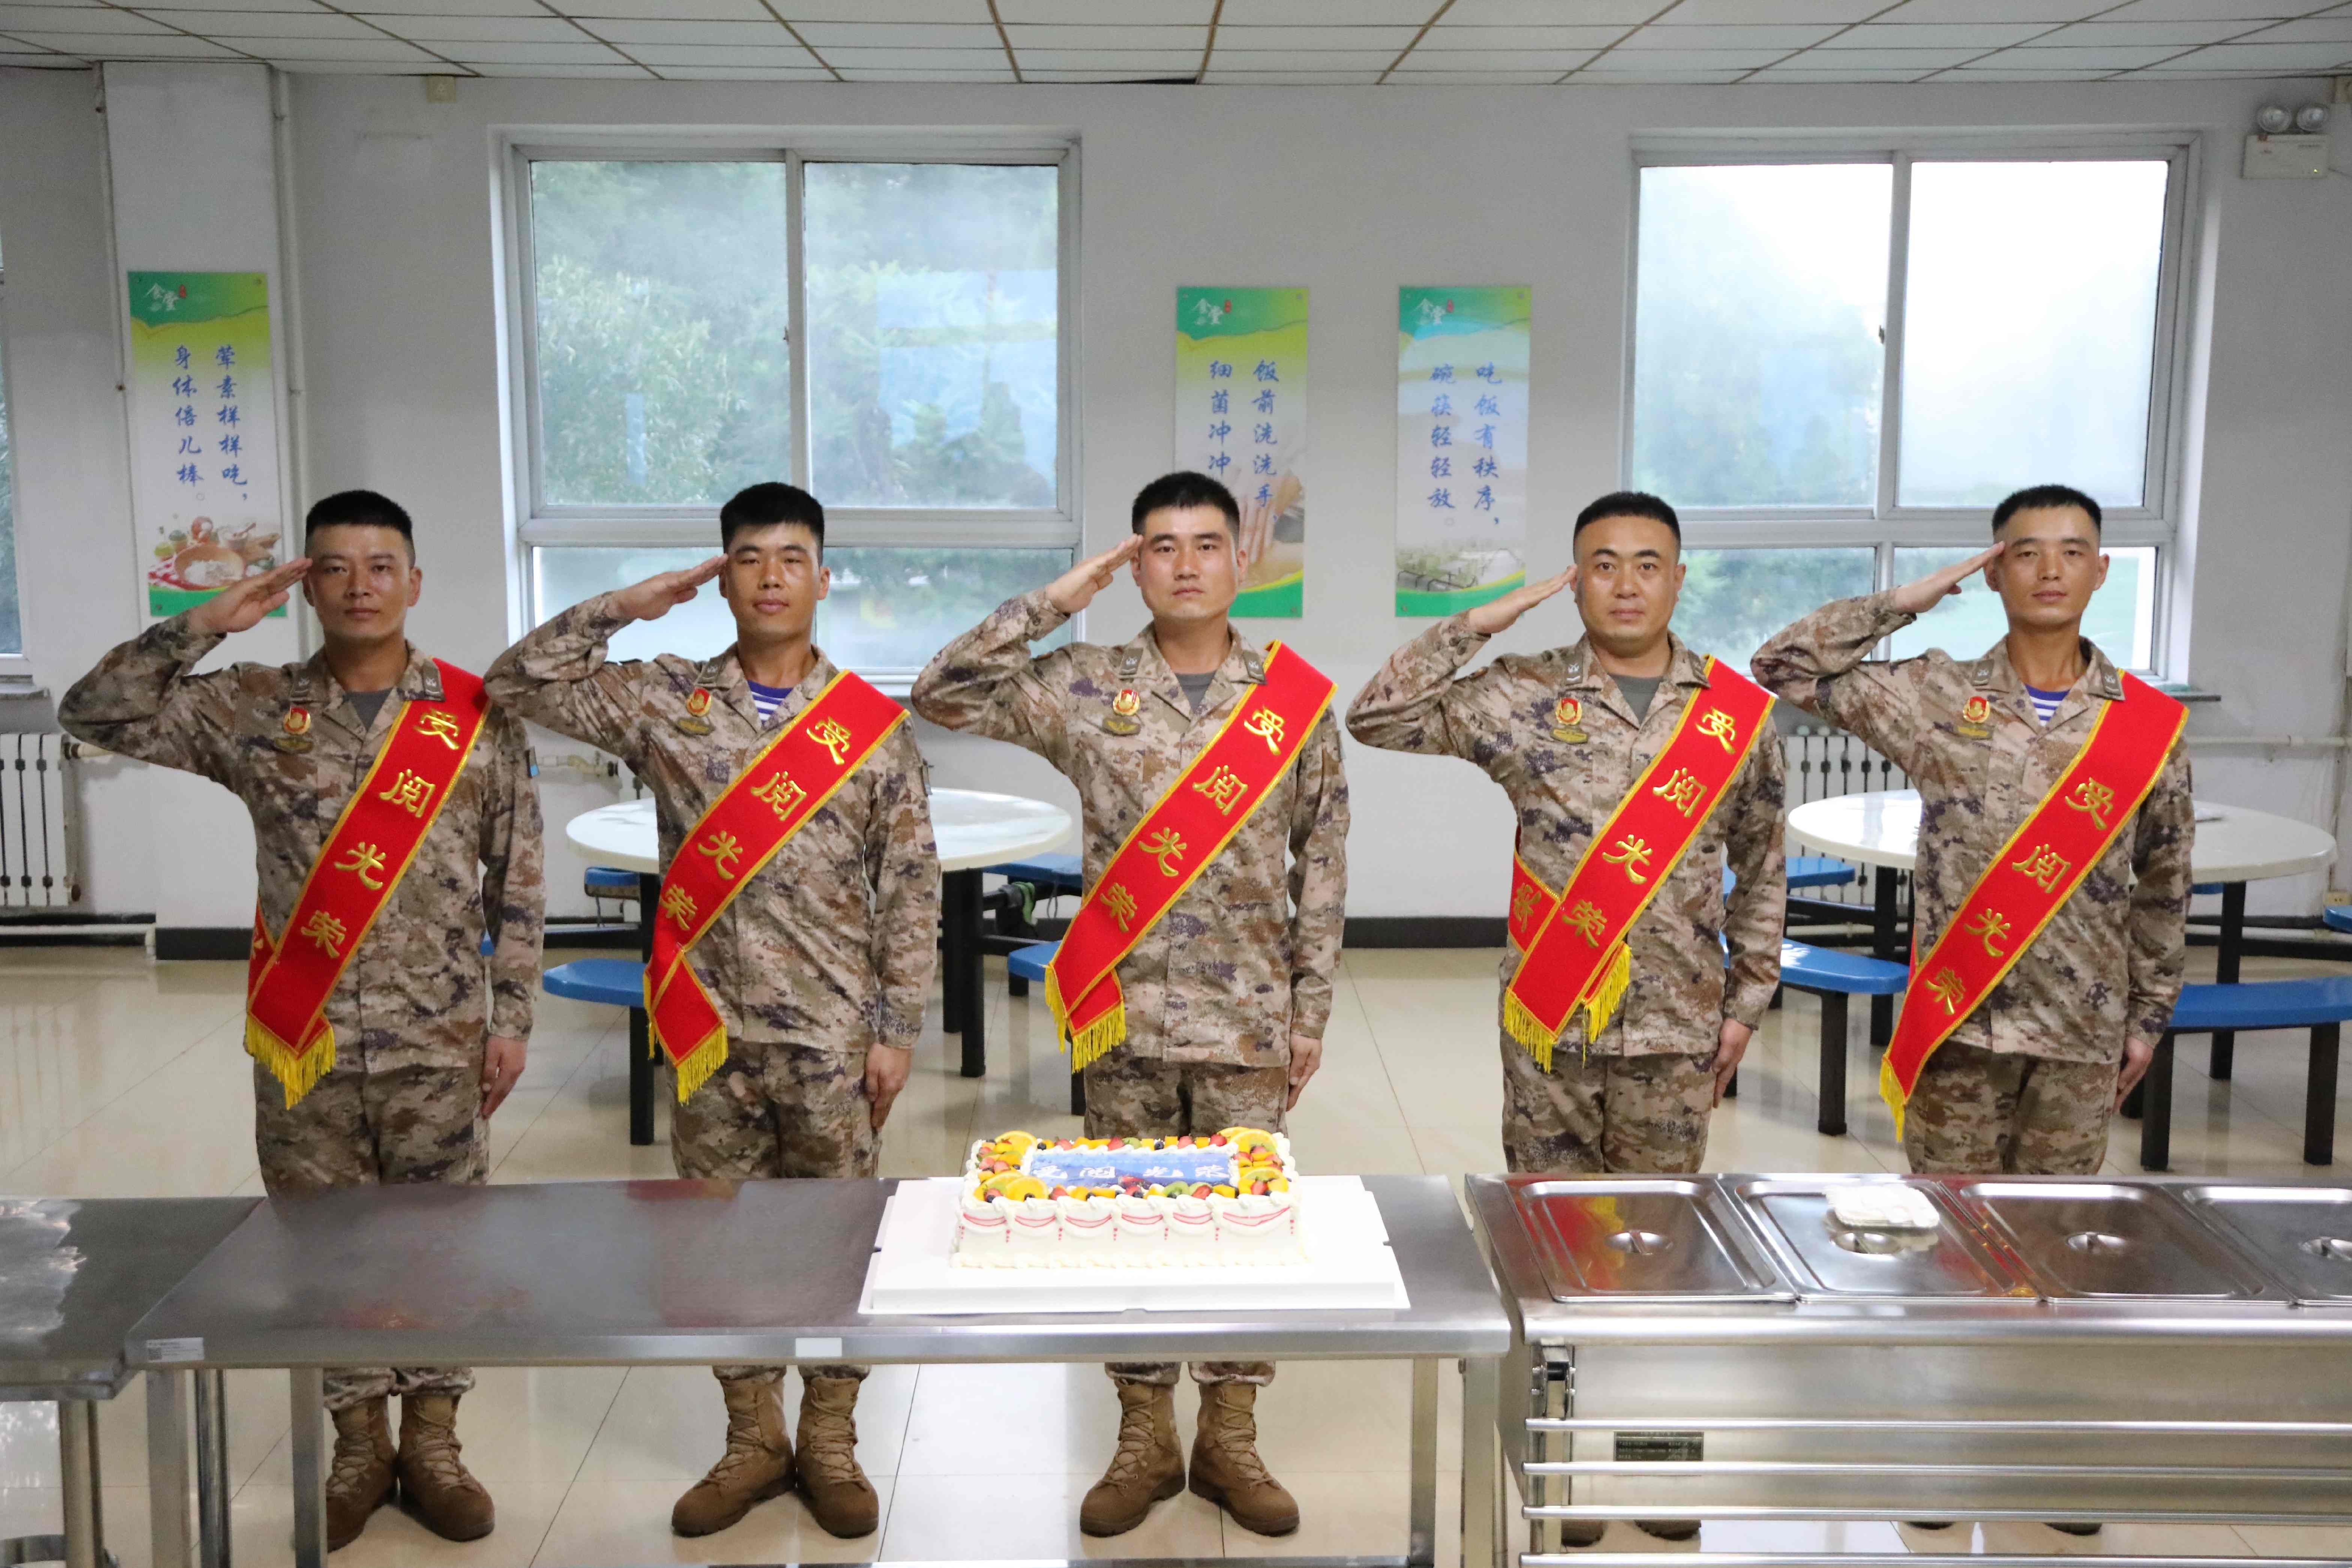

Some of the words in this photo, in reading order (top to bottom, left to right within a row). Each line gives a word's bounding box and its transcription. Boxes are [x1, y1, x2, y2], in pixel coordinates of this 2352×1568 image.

[1208, 360, 1233, 481] 细菌冲冲
[300, 708, 460, 959] 受阅光荣
[659, 717, 852, 930] 受阅光荣
[1100, 705, 1285, 933] 受阅光荣
[1562, 706, 1737, 948] 受阅光荣
[1924, 776, 2116, 1015] 受阅光荣
